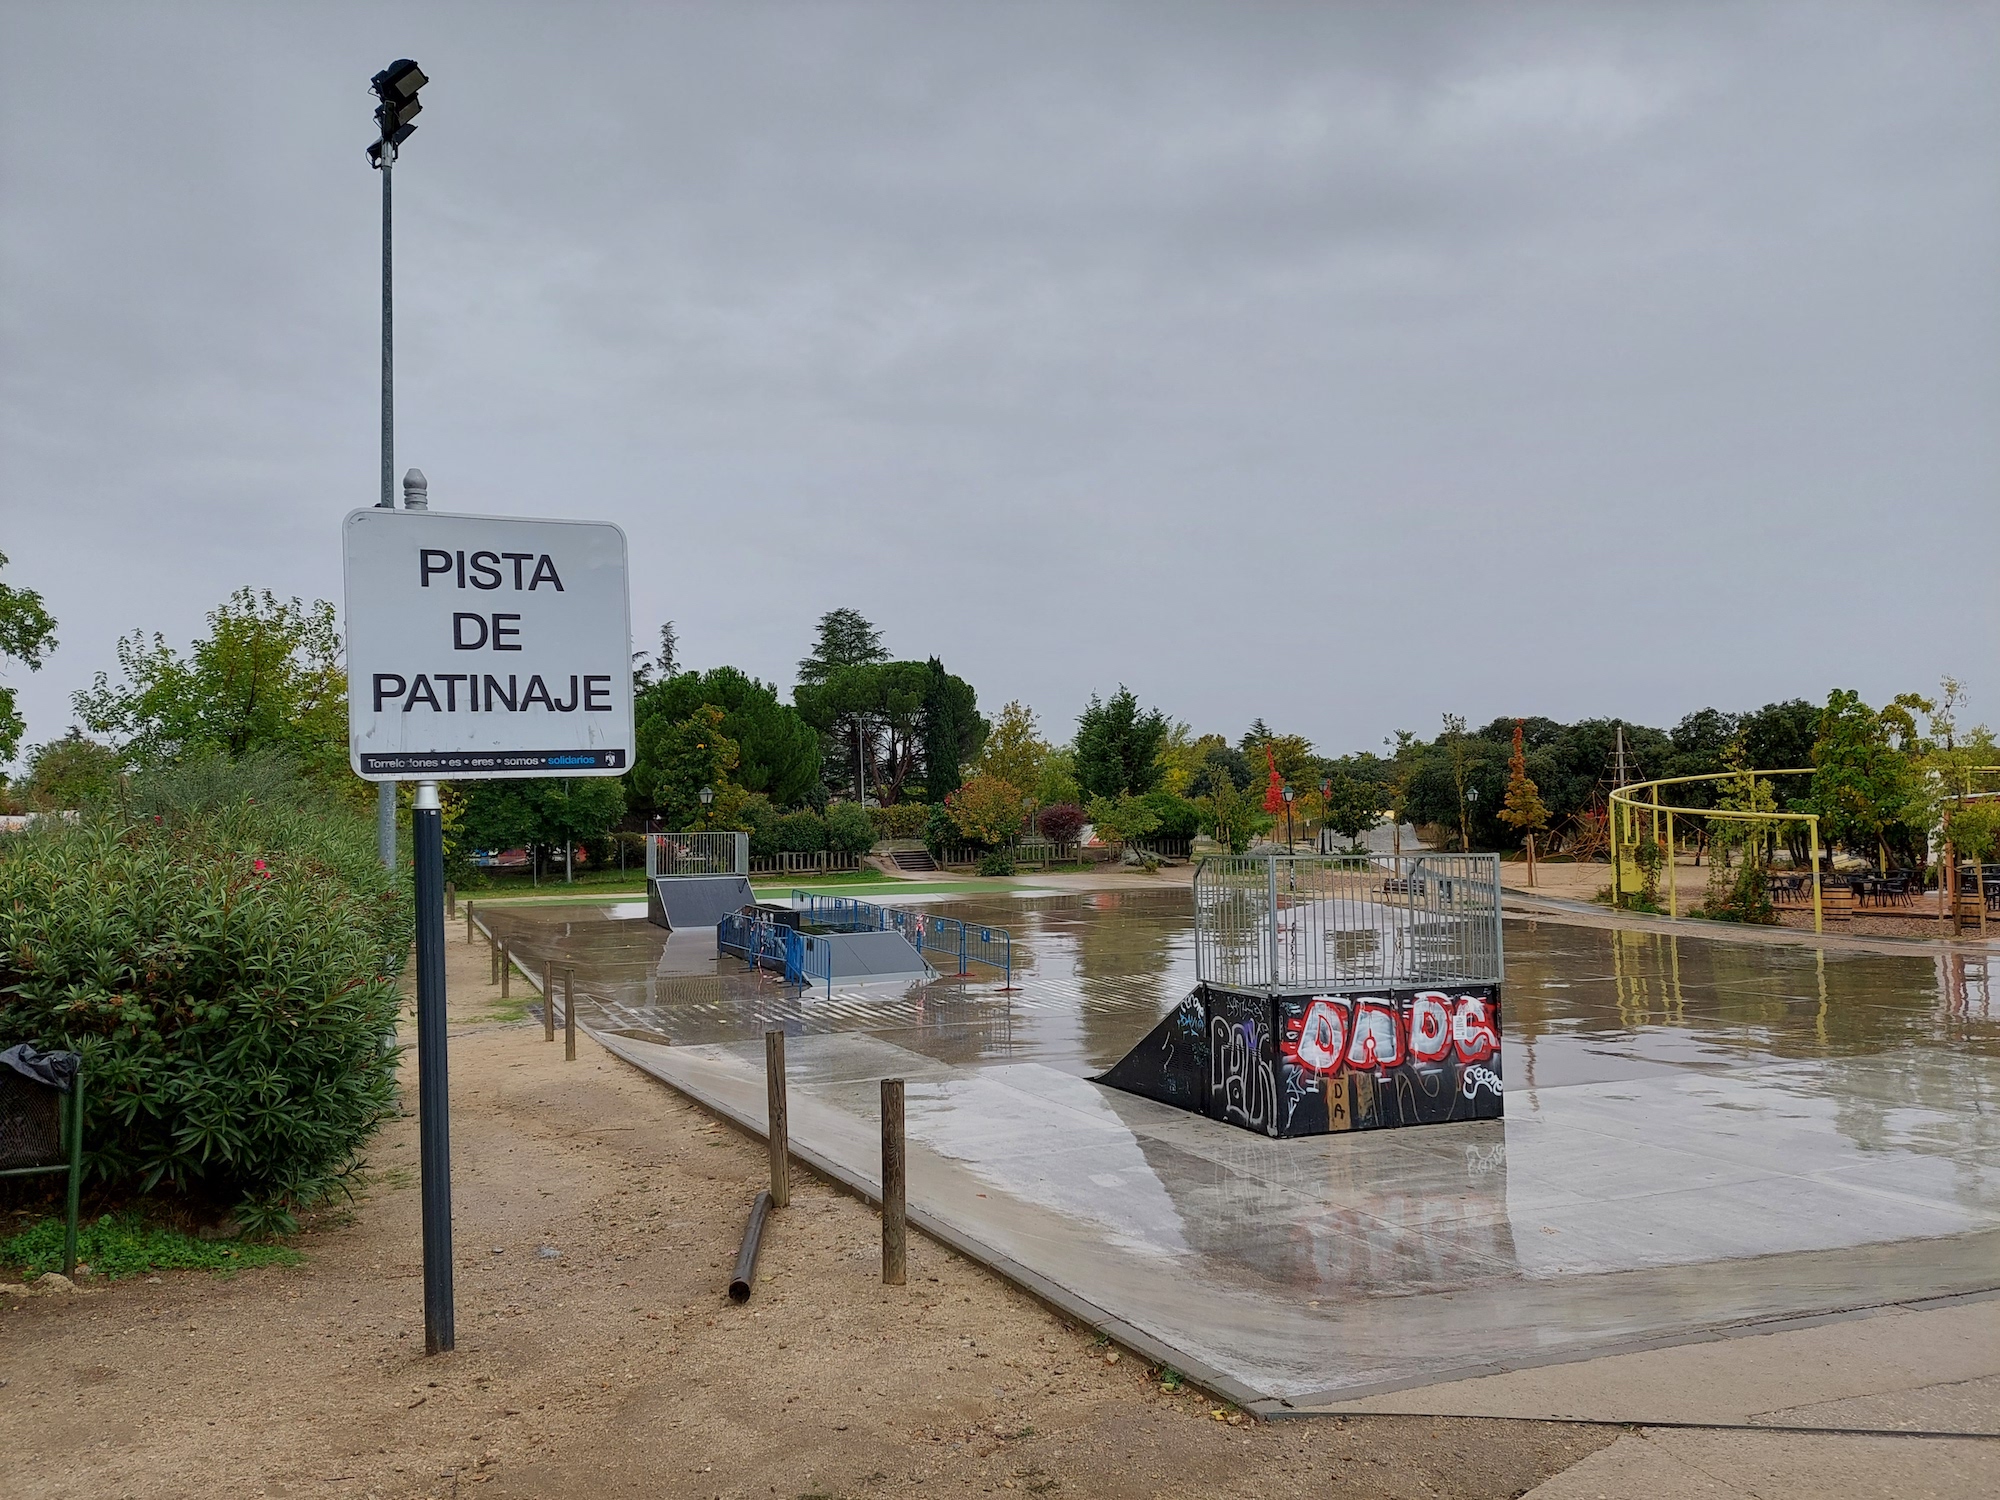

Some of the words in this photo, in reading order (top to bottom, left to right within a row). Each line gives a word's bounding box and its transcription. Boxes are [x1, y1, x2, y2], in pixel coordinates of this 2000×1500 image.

[419, 548, 565, 592] PISTA
[453, 612, 523, 651] DE
[373, 673, 613, 713] PATINAJE
[448, 758, 462, 767] es
[471, 758, 494, 767] eres
[504, 757, 539, 766] somos
[548, 755, 596, 765] solidarios
